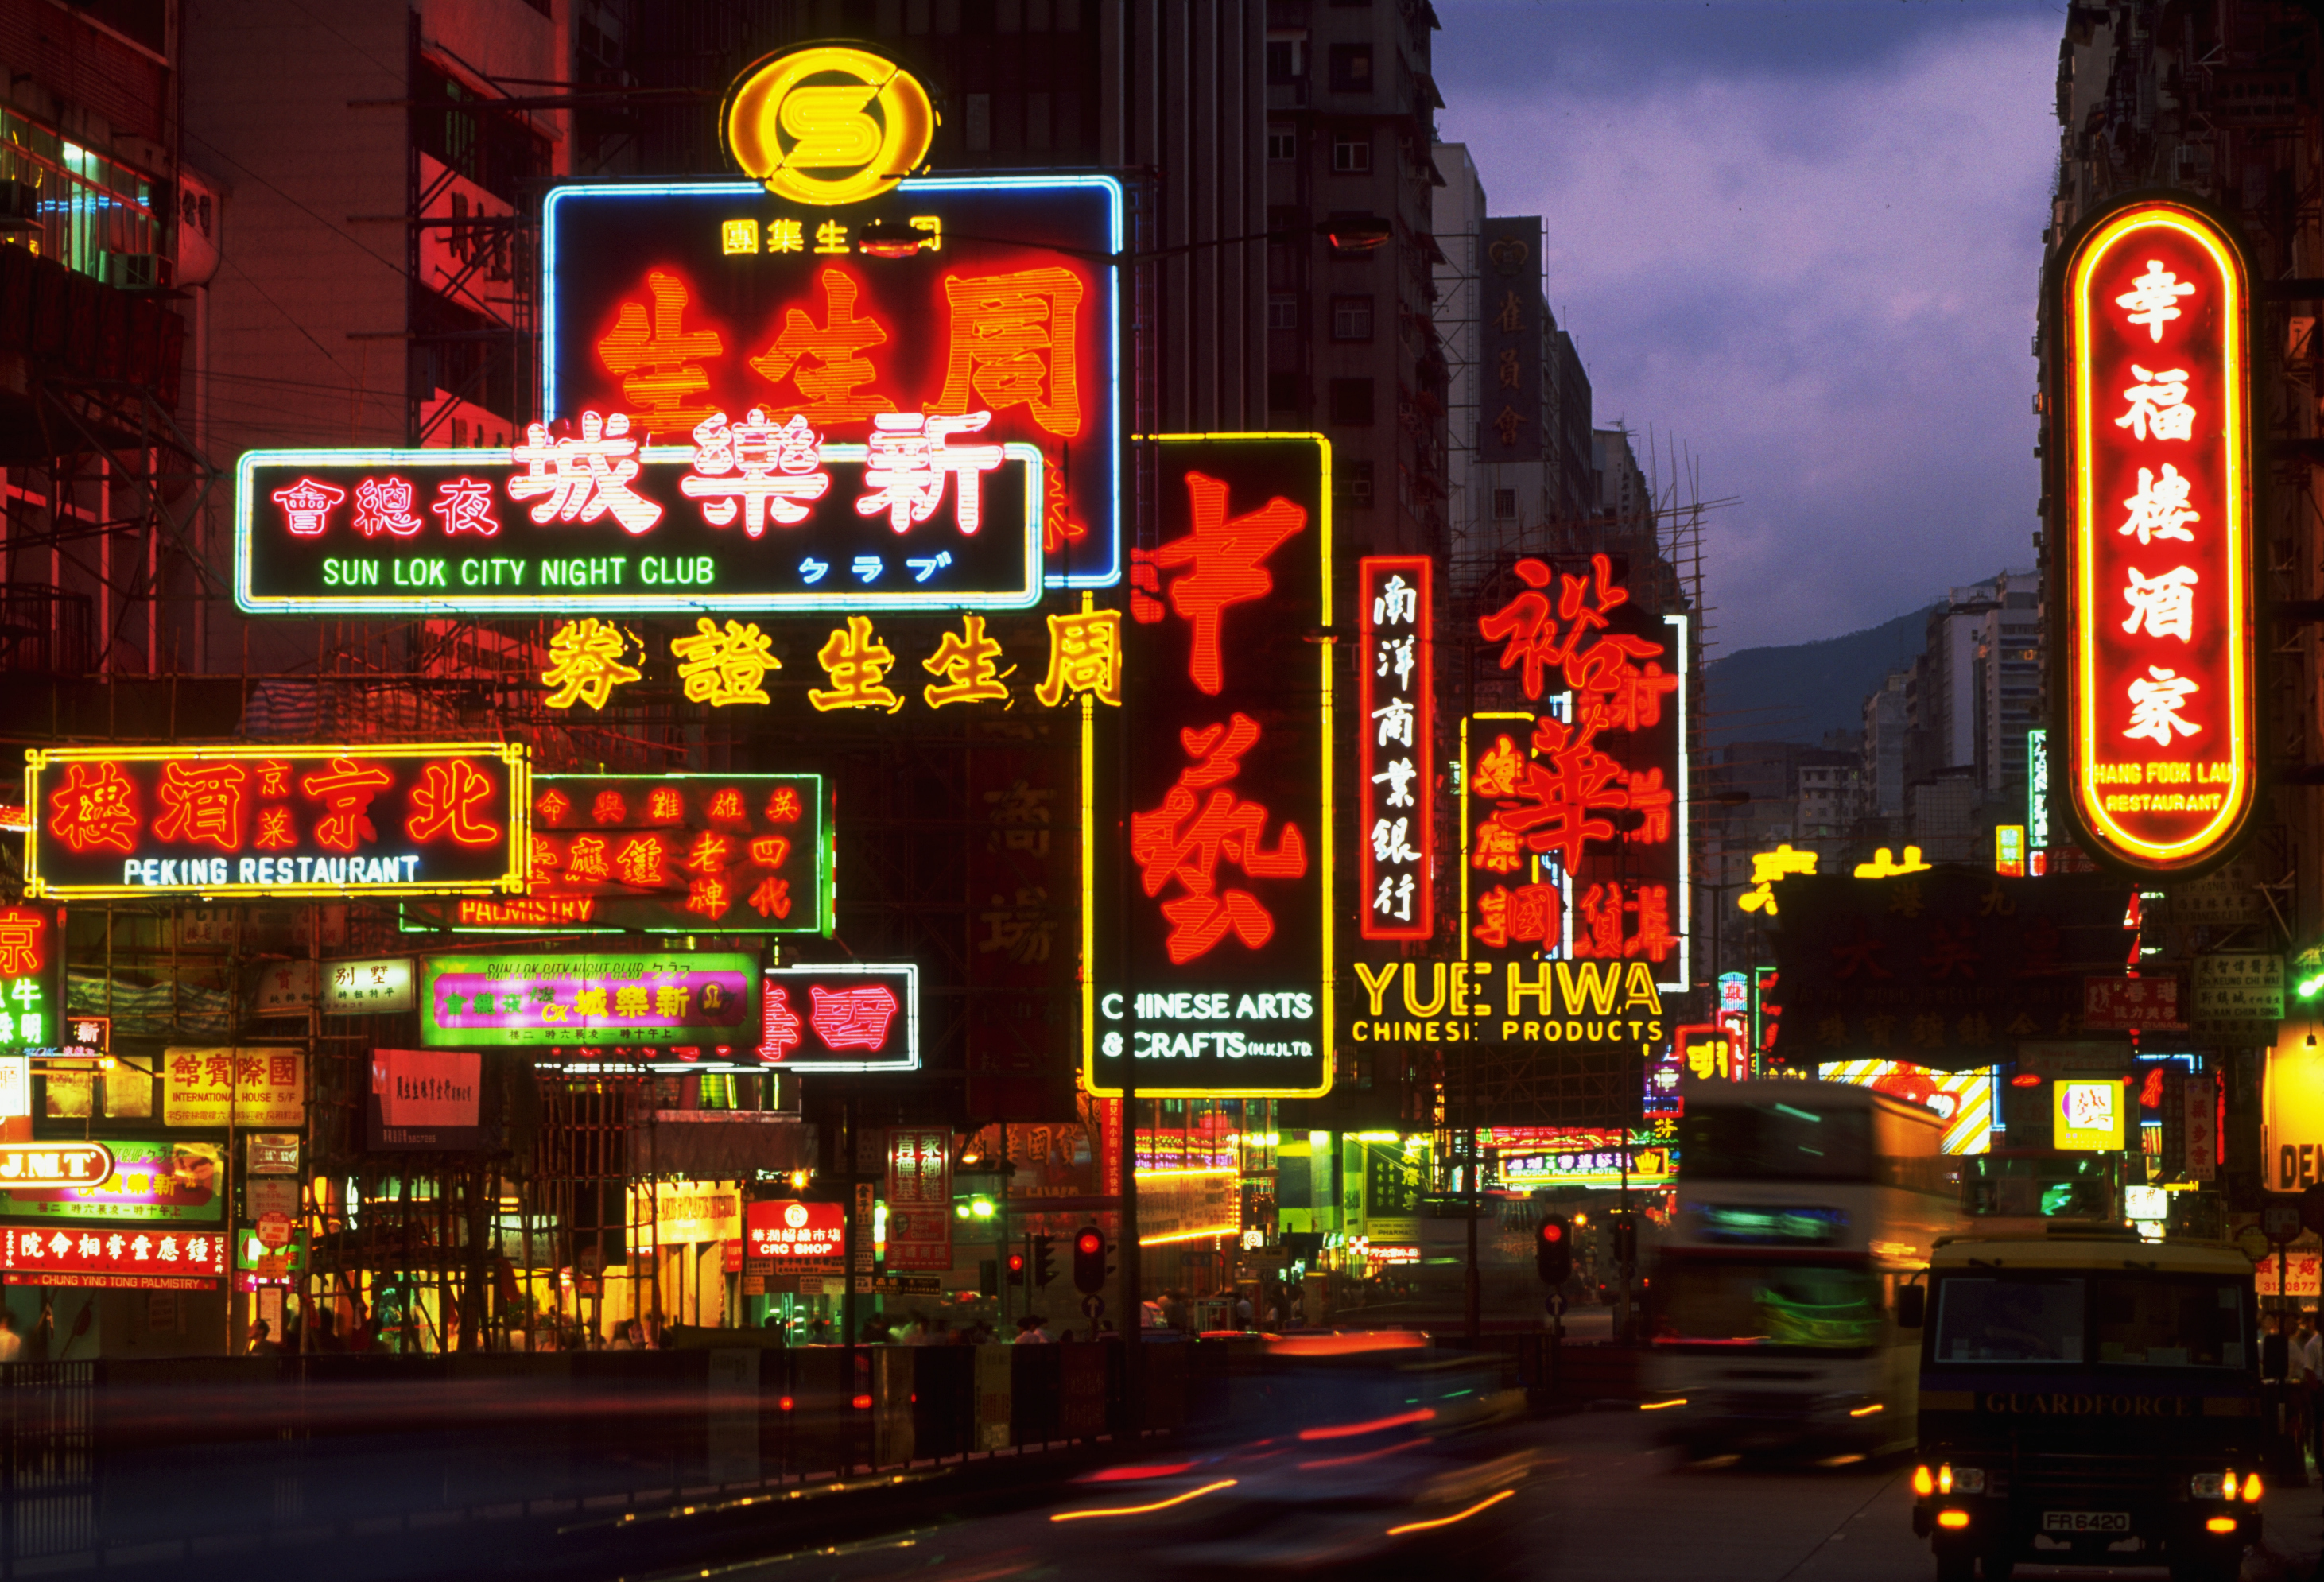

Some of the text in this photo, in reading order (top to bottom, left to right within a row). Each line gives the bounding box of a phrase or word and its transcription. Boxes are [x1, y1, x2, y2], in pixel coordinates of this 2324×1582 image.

[324, 556, 714, 586] SUN LOK CITY NIGHT CLUB
[799, 551, 951, 584] クラブ
[1371, 574, 1422, 922] 南洋商業銀行
[2094, 763, 2232, 784] HANG FOOK LAU
[2106, 793, 2221, 813] RESTAURANT
[124, 855, 419, 886] PEKING RESTAURANT
[541, 964, 569, 981] CITY
[572, 964, 607, 981] NIGHT
[1354, 962, 1491, 1016] YUE
[1507, 962, 1662, 1016] HWA
[1237, 992, 1313, 1020] ARTS
[1503, 1020, 1662, 1041] PRODUCTS
[1102, 1032, 1123, 1058] &
[242, 1092, 271, 1103] HOUSE
[277, 1092, 295, 1103] 5/F
[910, 1214, 945, 1224] Kentucky
[910, 1222, 929, 1231] Fried
[910, 1230, 939, 1239] Chicken
[760, 1243, 833, 1254] CRC SHOP
[42, 1275, 200, 1289] CHUNG YING TONG PALMISTRY
[2264, 1281, 2316, 1292] 310877
[1986, 1392, 2194, 1417] GUARDFORCE
